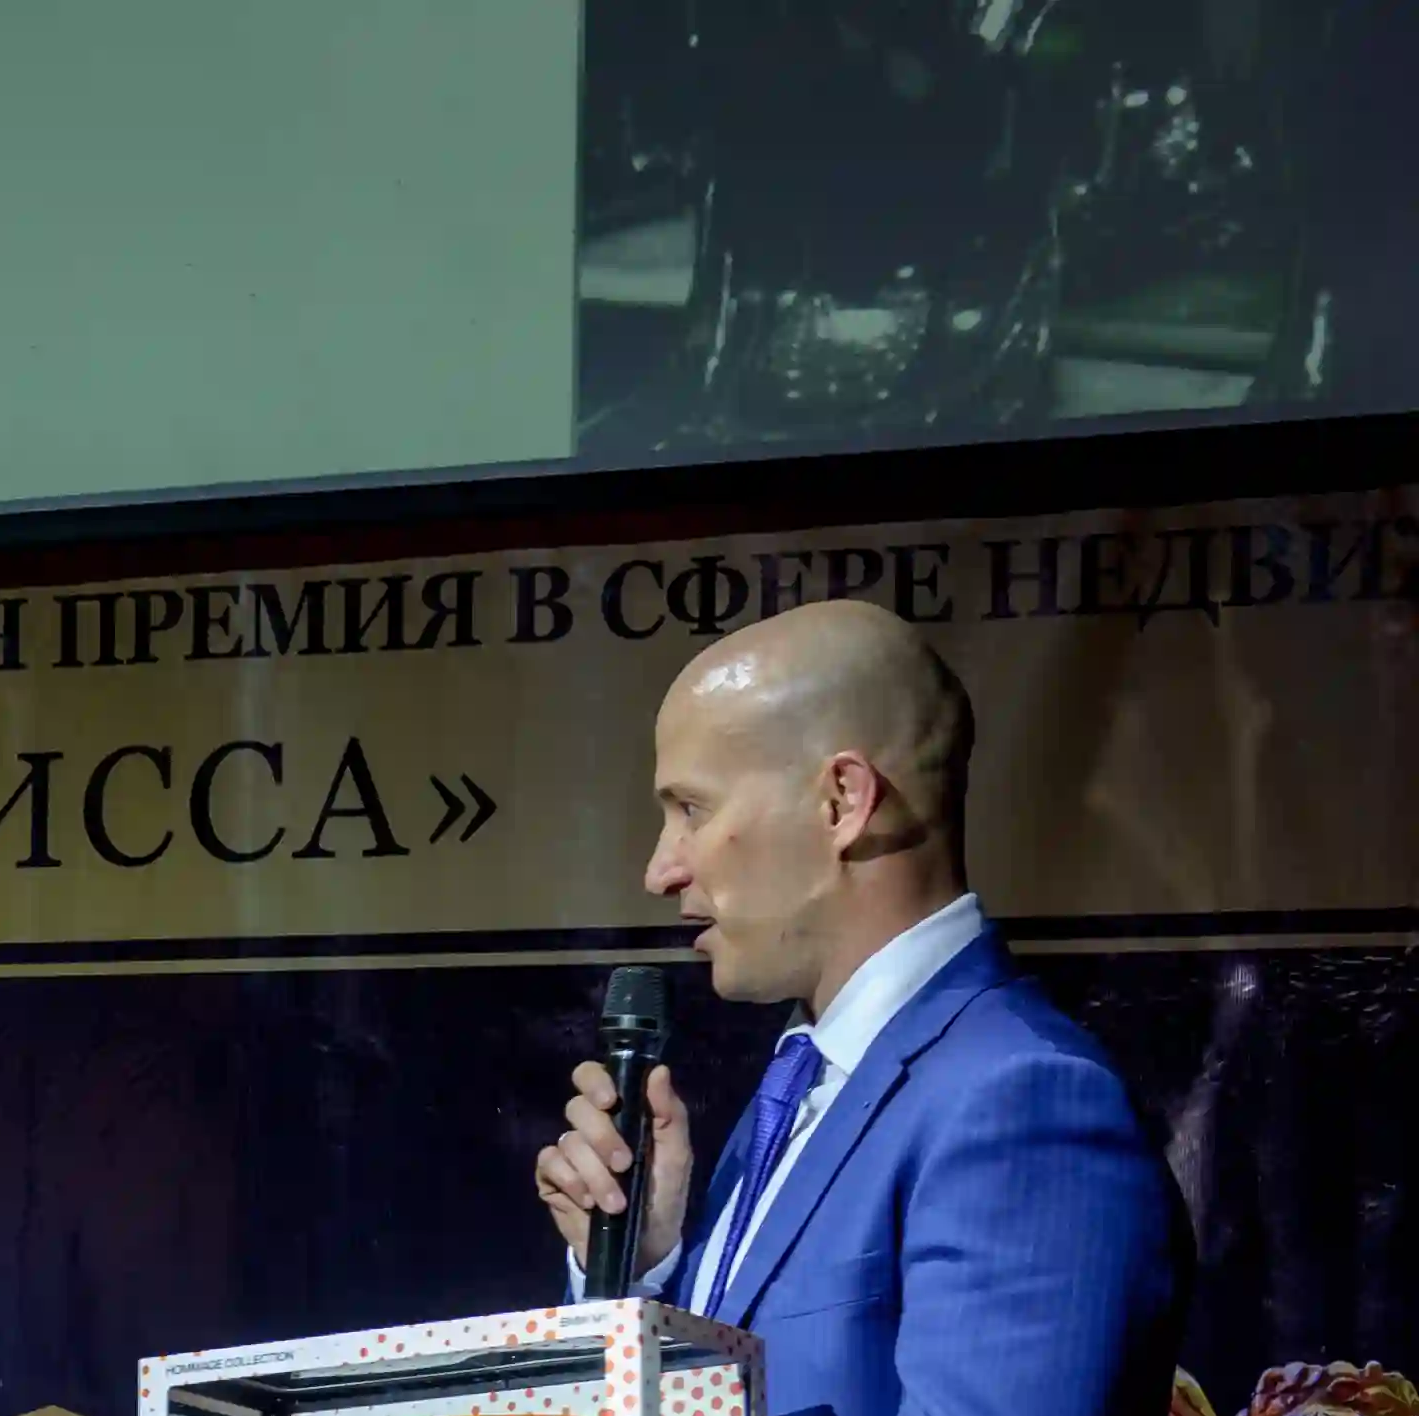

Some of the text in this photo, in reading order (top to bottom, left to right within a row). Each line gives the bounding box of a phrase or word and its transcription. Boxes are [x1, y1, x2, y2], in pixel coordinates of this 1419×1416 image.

[52, 567, 484, 668] ПРЕМИЯ
[508, 564, 573, 645] В
[601, 544, 954, 639] СФЕРЕ
[226, 1350, 295, 1368] COLLECTION
